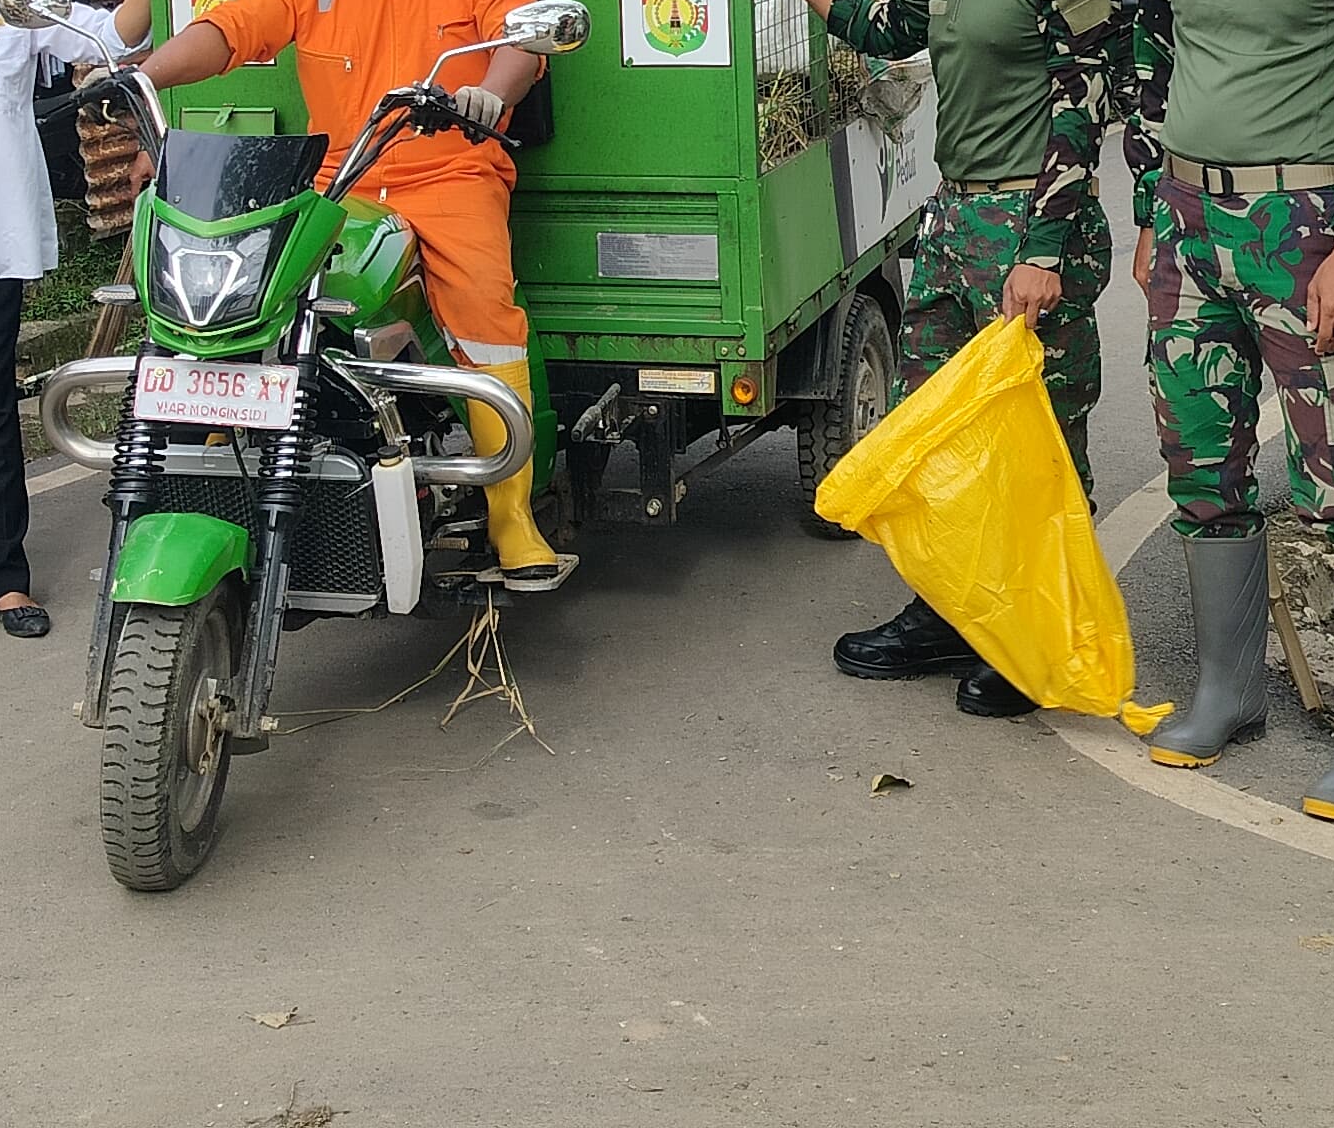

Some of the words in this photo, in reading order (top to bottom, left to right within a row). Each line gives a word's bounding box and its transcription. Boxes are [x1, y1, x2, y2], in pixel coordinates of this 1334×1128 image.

[143, 367, 175, 393] DD
[186, 369, 246, 398] 3656
[256, 375, 291, 404] XY
